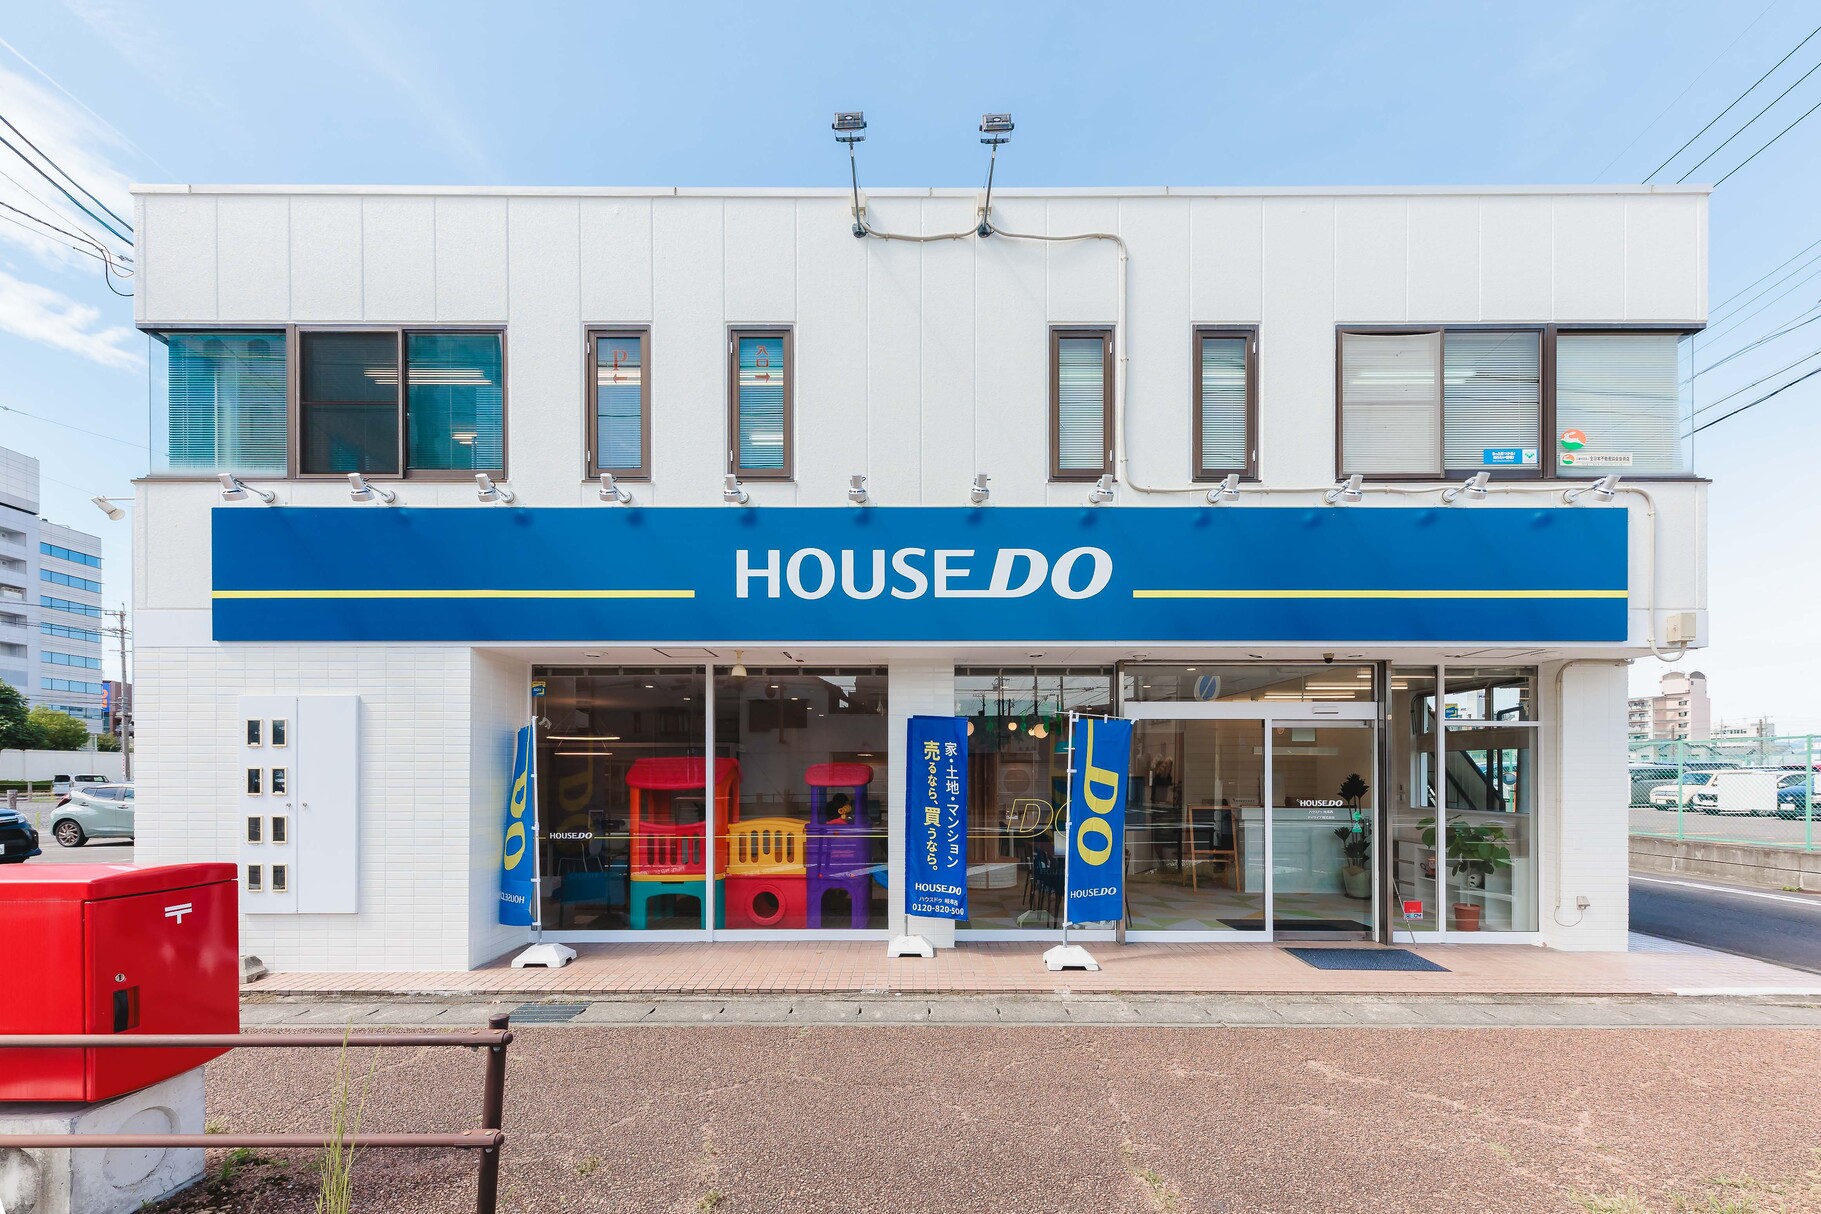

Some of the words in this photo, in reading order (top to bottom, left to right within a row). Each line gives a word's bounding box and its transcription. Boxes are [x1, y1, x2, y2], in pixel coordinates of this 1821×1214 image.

[612, 350, 628, 371] P
[735, 547, 987, 600] HOUSE
[988, 546, 1113, 600] DO
[923, 740, 941, 871] 売るなら、買うなら。
[944, 741, 959, 868] 家・土地・マンション
[1300, 799, 1329, 807] HOUSE
[1329, 799, 1343, 807] DO
[915, 882, 948, 893] HOUSE
[948, 885, 962, 895] DO
[1070, 887, 1099, 899] HOUSE
[1099, 886, 1117, 896] DO
